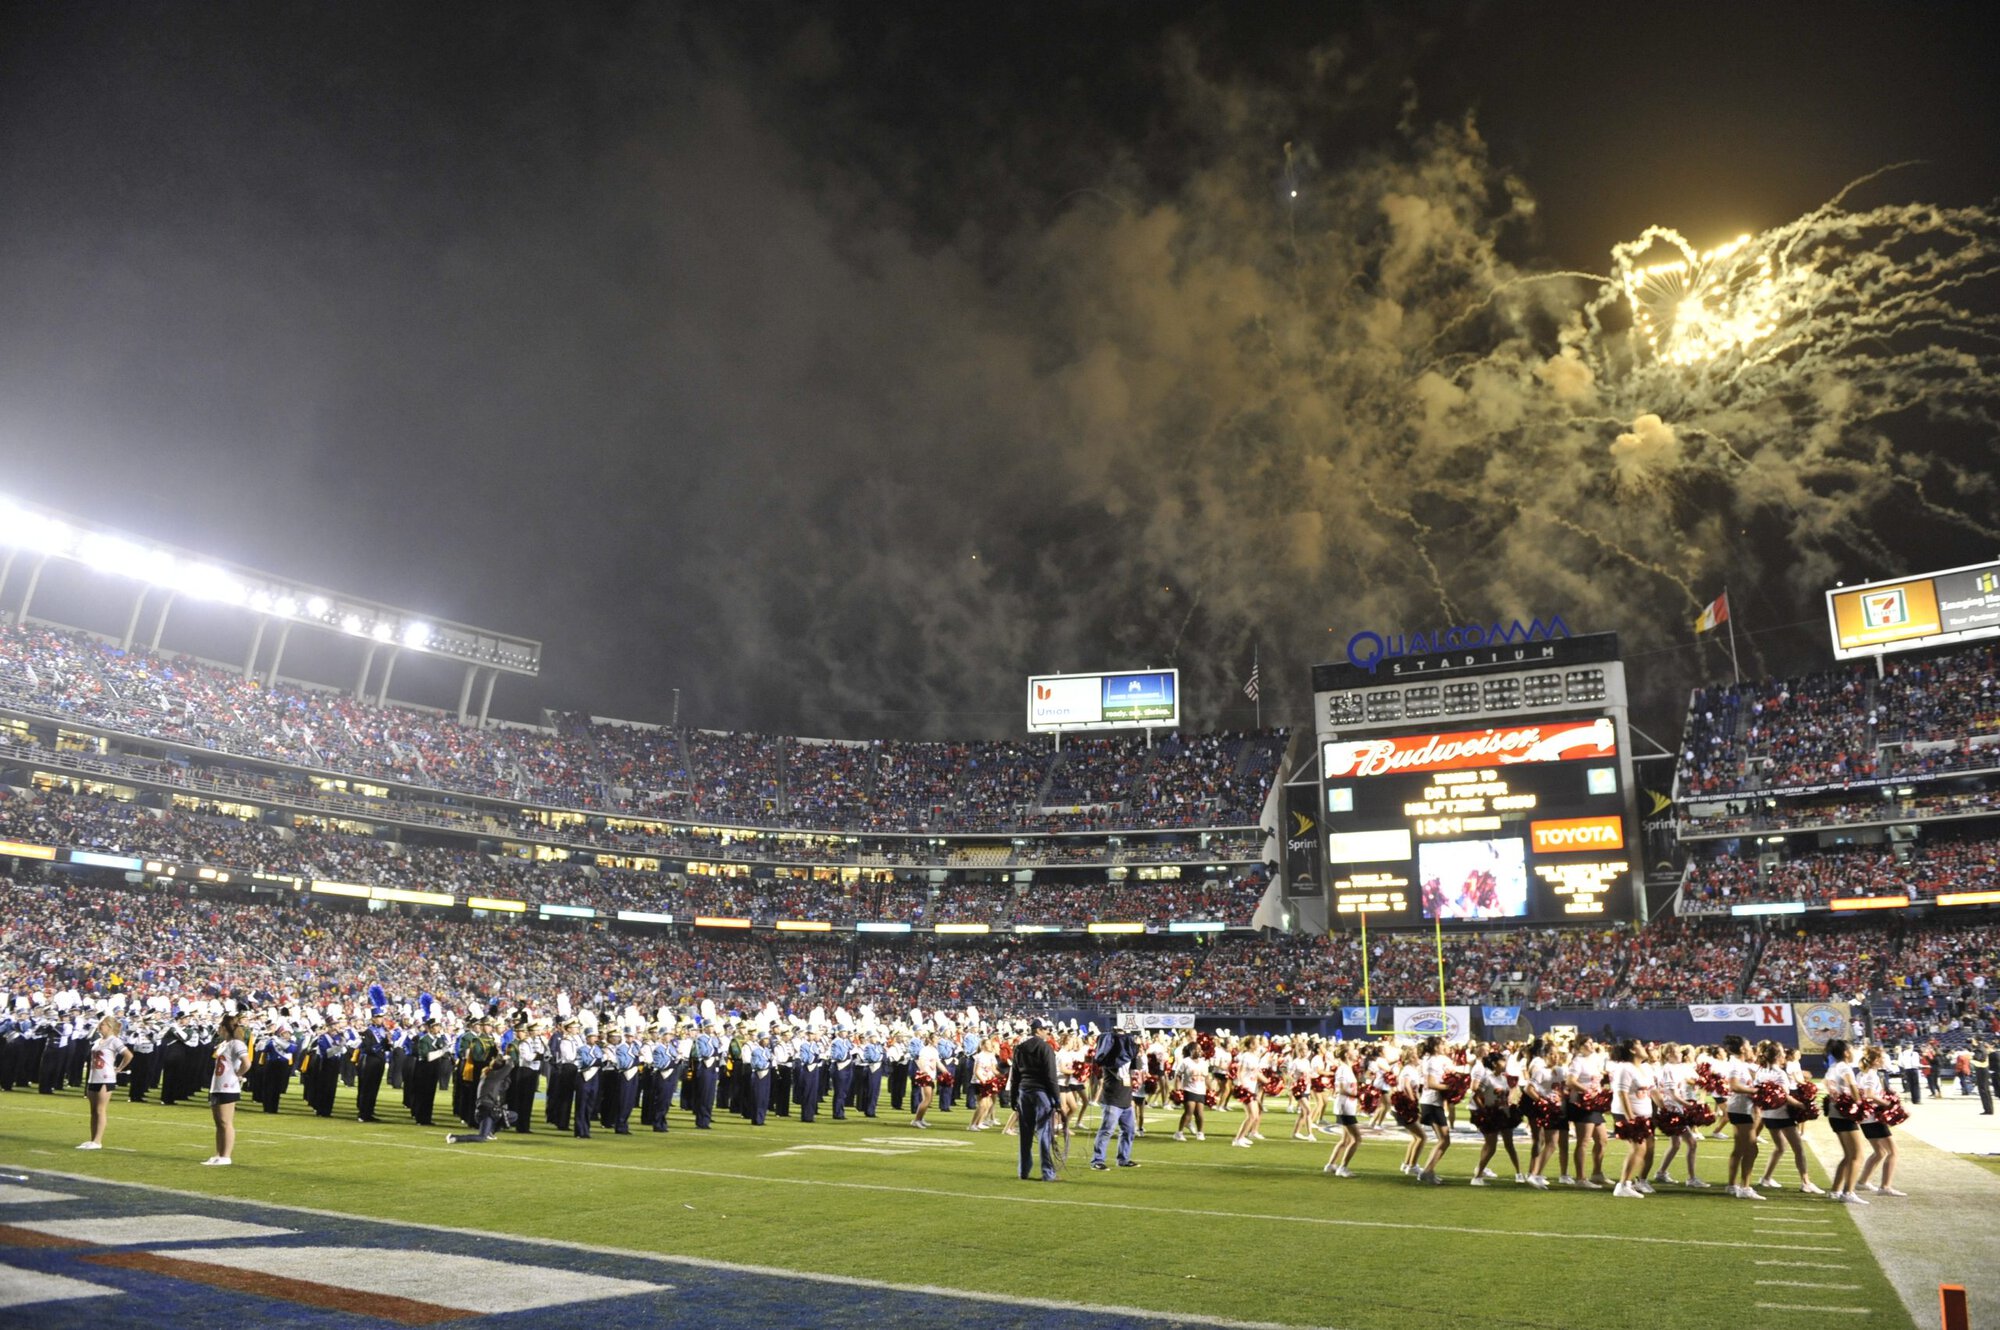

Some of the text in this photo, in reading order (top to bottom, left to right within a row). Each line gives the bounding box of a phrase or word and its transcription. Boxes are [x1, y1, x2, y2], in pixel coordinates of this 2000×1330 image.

[1347, 615, 1571, 674] QUALCOMM
[1394, 647, 1554, 673] STADIUM
[1037, 708, 1071, 716] Union
[1352, 728, 1540, 776] Budweiser
[1641, 818, 1677, 832] Sprint
[1535, 825, 1618, 845] TOYOTA
[1288, 839, 1318, 852] Sprint
[1123, 1014, 1139, 1030] A
[1762, 1006, 1784, 1024] N
